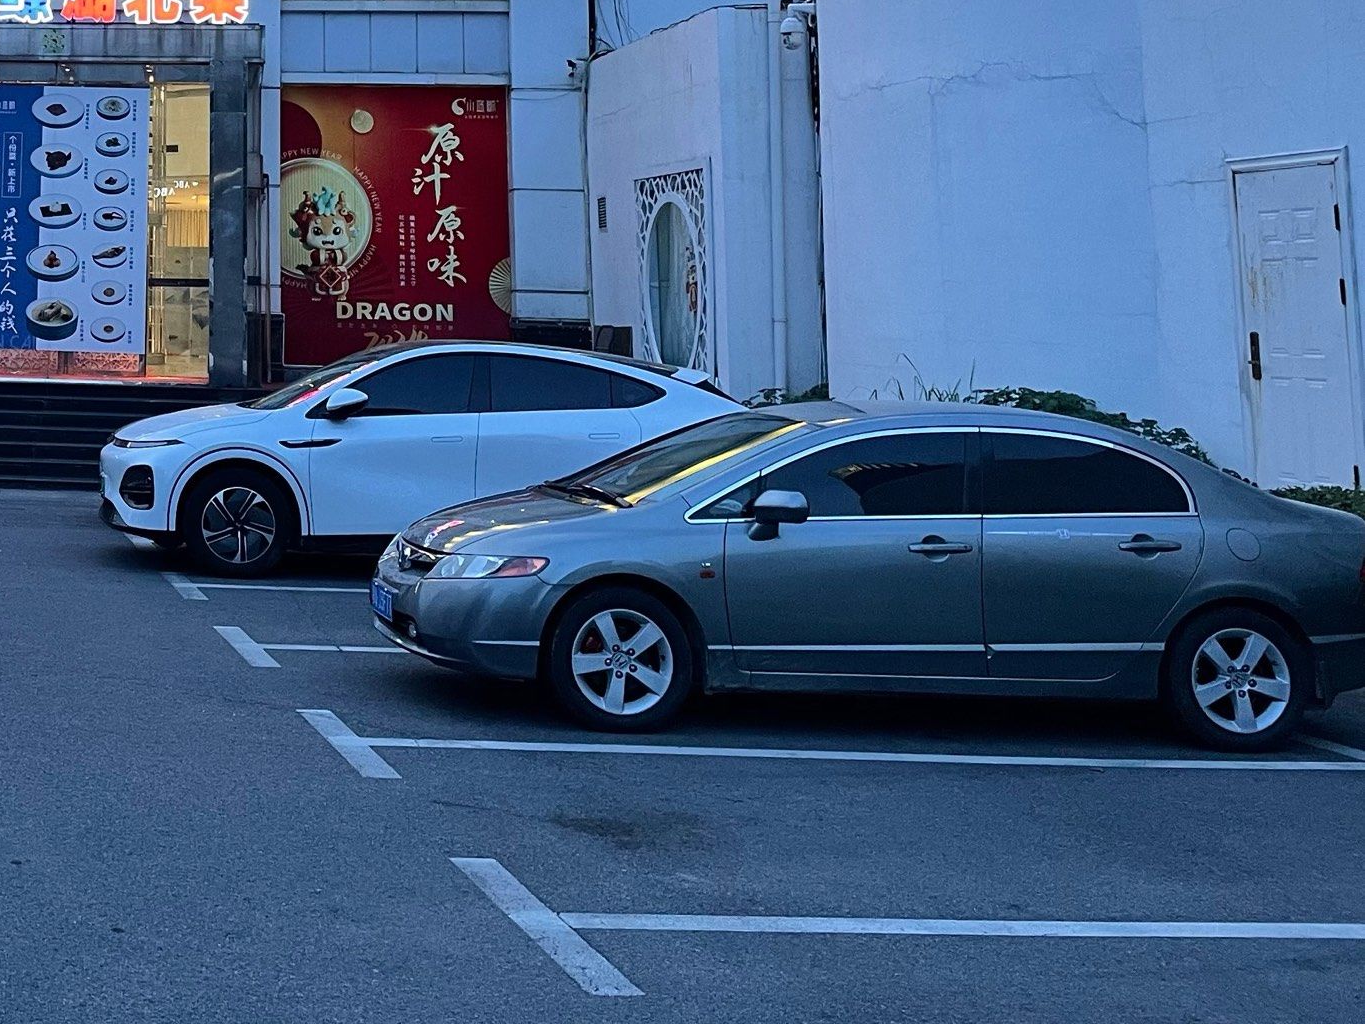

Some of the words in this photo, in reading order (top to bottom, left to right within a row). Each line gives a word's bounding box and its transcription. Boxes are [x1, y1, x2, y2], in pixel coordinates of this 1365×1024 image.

[411, 123, 468, 288] 原汁原味
[0, 207, 18, 334] 只花三个人的钱
[336, 301, 454, 322] DRAGON
